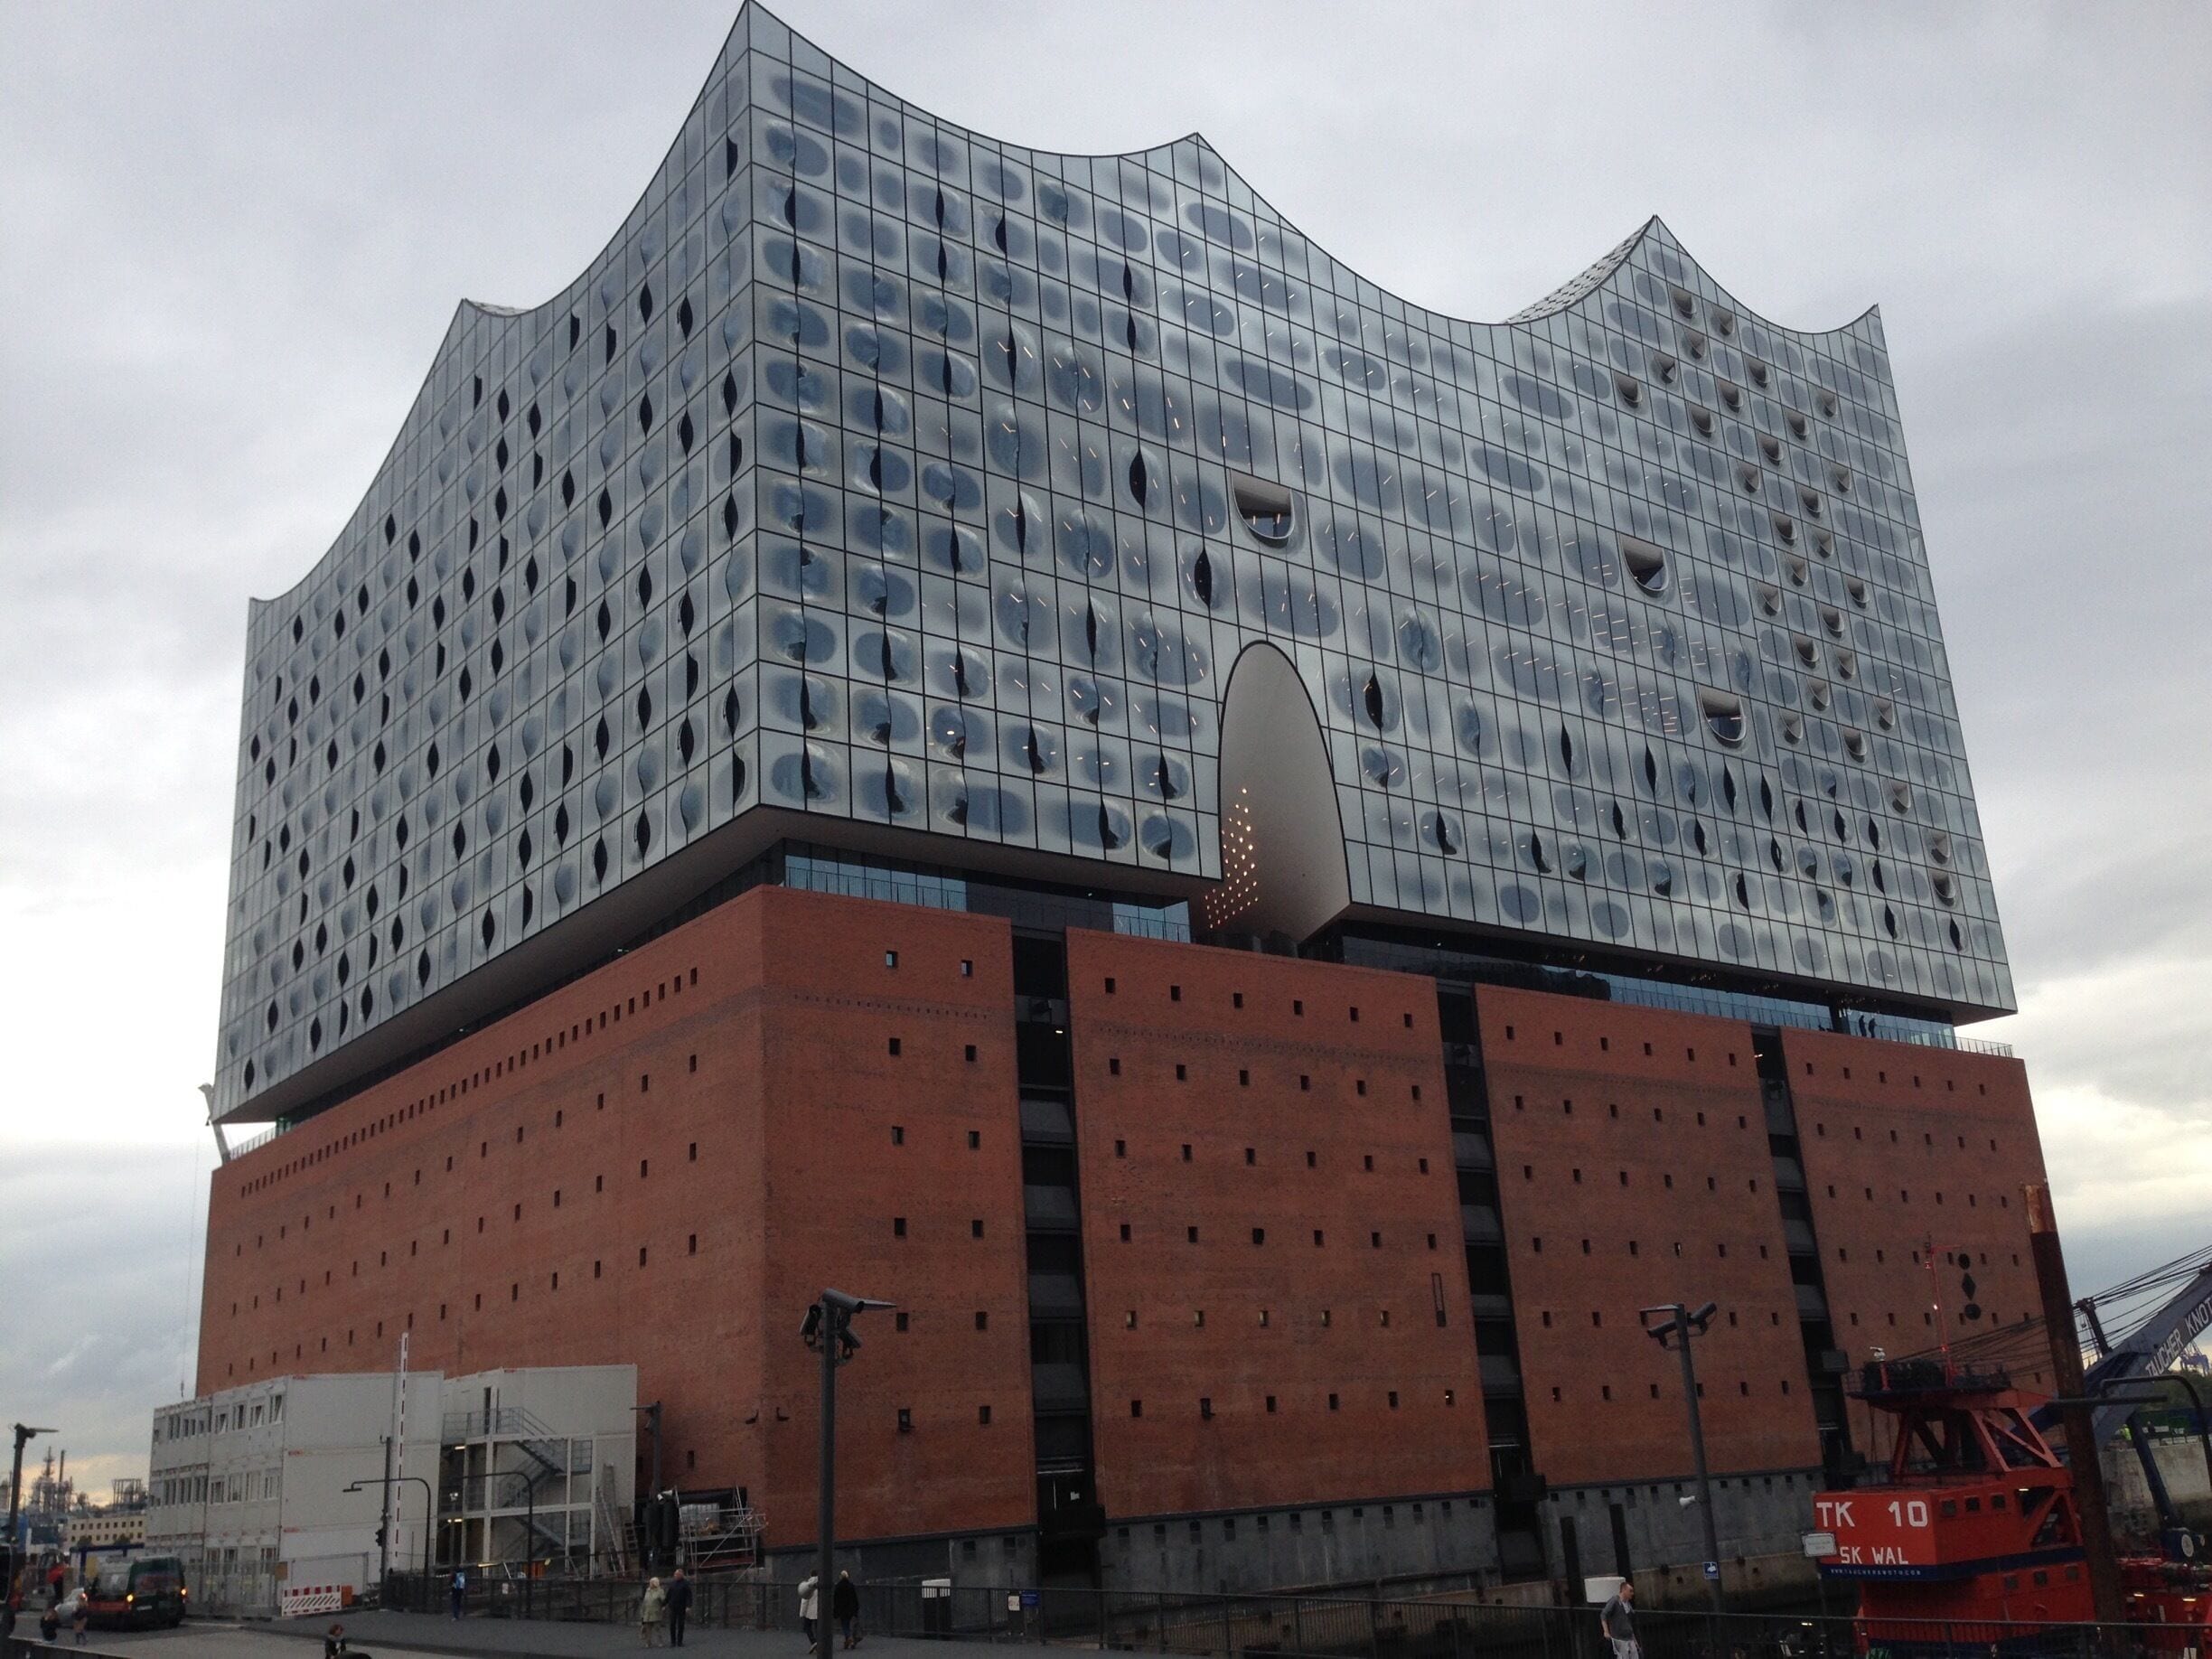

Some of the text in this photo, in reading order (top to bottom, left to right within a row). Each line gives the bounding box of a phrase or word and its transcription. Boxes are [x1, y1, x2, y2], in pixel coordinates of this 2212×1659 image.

[2145, 1328, 2184, 1376] TAUCHER
[1816, 1501, 1928, 1527] TK 10
[1840, 1546, 1908, 1565] SK WAL
